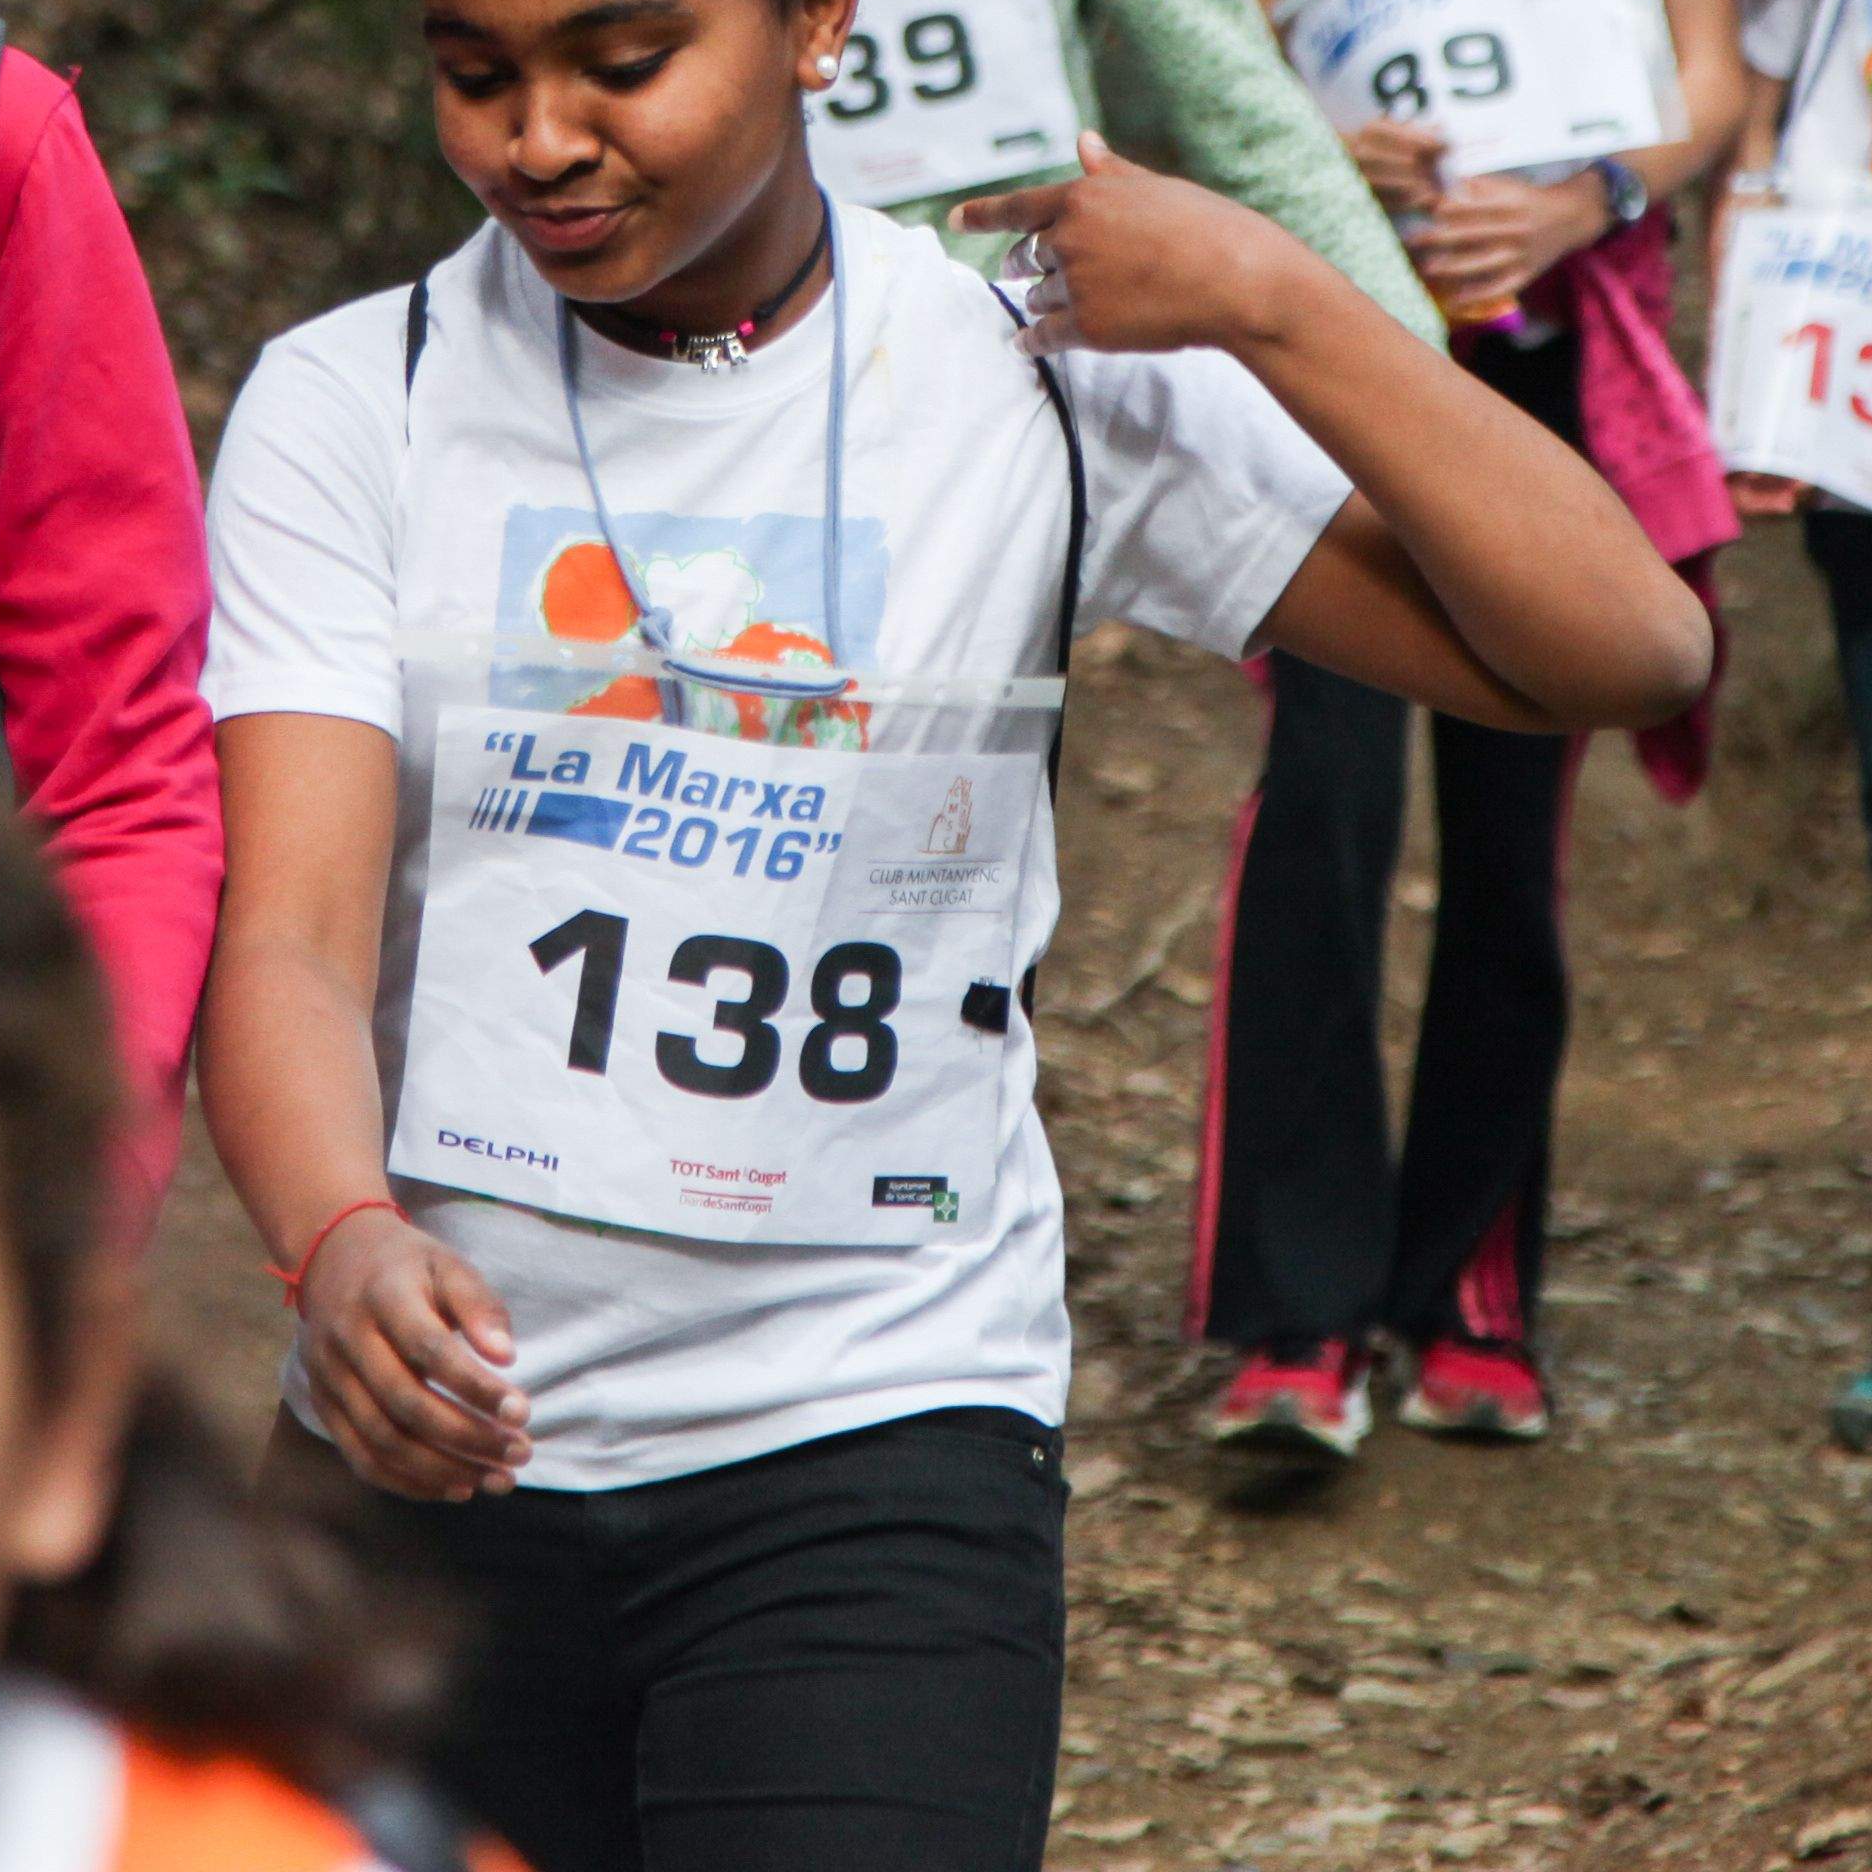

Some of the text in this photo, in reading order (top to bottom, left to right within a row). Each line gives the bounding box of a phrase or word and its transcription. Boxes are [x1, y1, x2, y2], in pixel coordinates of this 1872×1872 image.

[616, 741, 827, 824] Marxa
[888, 888, 927, 906] SANT
[528, 908, 903, 1105] 138
[437, 1129, 560, 1172] DELPHI
[670, 1159, 788, 1187] TOT Sant Cugat
